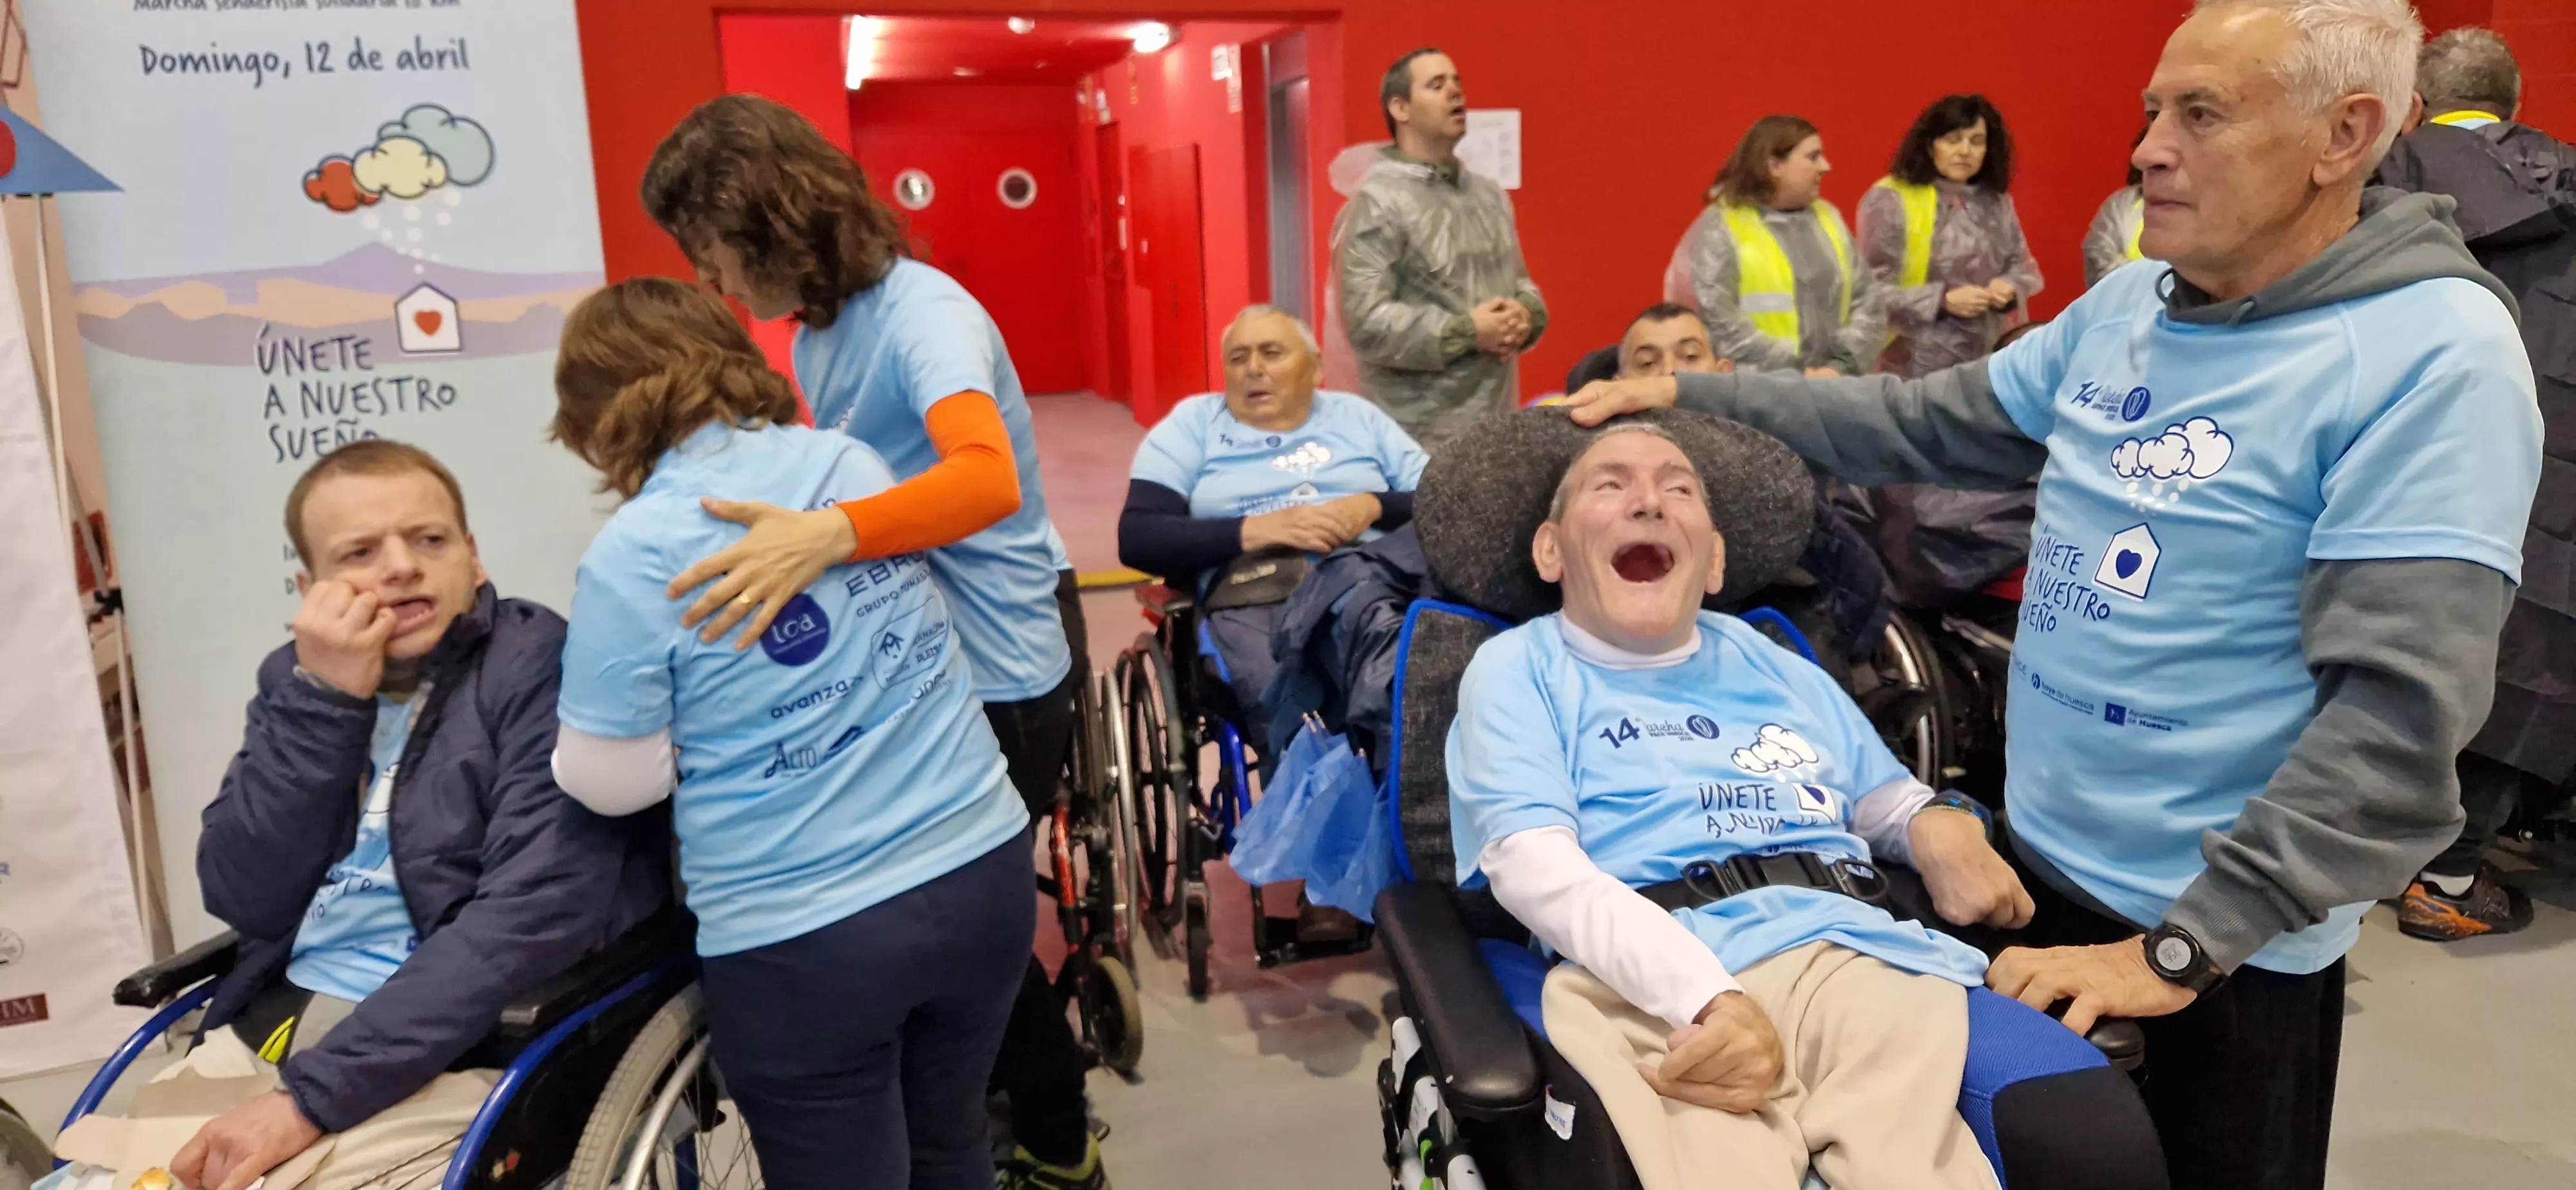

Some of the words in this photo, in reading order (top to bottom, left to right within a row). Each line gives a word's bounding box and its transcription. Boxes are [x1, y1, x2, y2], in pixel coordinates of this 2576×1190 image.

[139, 42, 290, 89] Domingo,
[305, 41, 336, 73] 12
[347, 35, 384, 71] de
[396, 33, 471, 71] abril
[257, 323, 375, 376] ÚNETE
[264, 384, 286, 420] A
[300, 376, 458, 420] NUESTRO
[856, 590, 899, 618] GRUPO
[2020, 593, 2057, 633] UEÑO
[2032, 567, 2110, 622] NUESTRO
[771, 679, 849, 719] avanza
